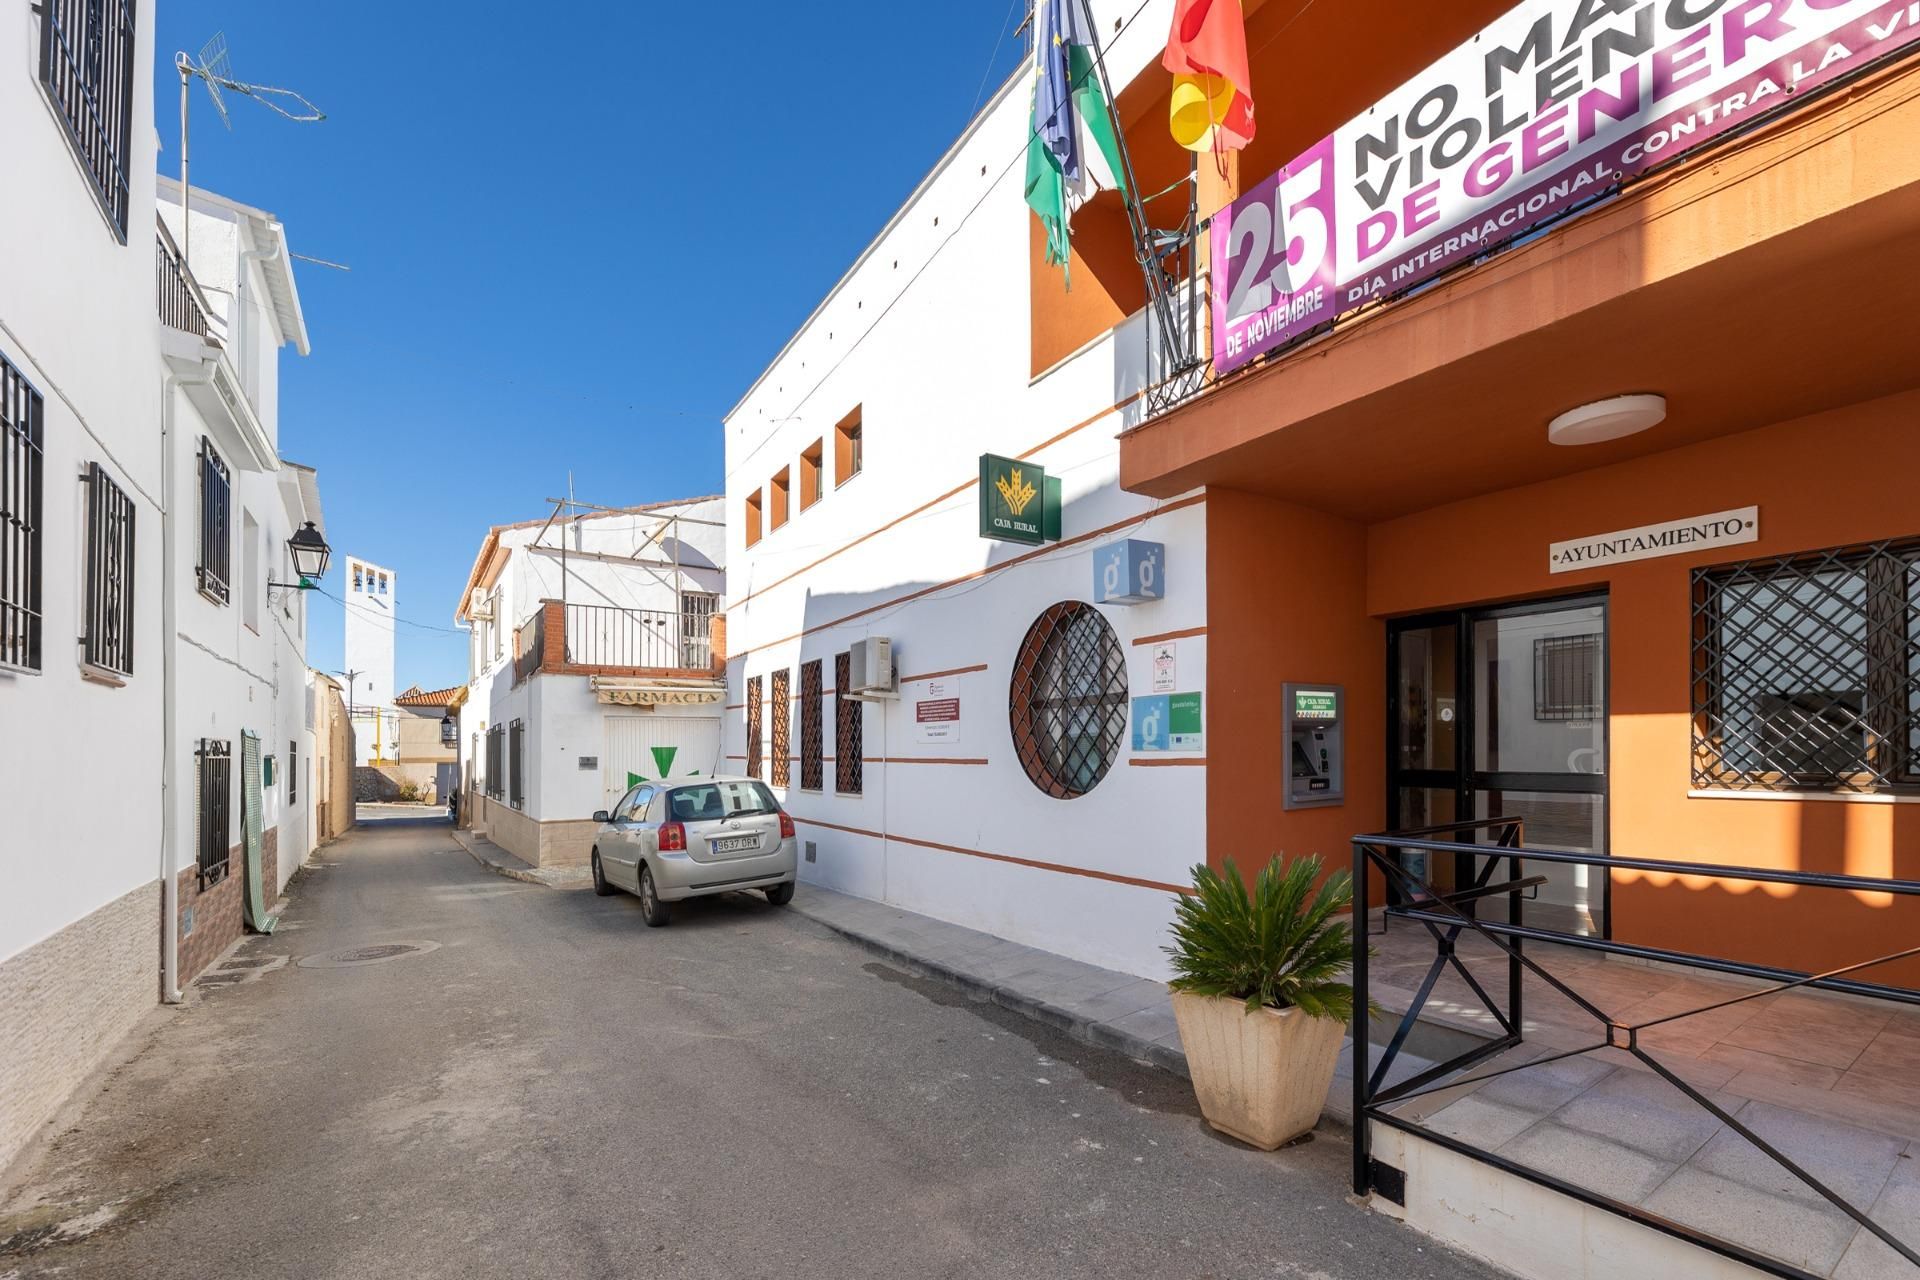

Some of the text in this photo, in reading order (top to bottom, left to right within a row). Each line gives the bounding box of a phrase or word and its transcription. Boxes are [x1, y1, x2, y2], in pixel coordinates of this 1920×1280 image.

[1356, 84, 1458, 179] NO
[1357, 0, 1843, 263] DE GÉNER
[1348, 278, 1386, 303] DÍA
[1391, 161, 1612, 282] INTERNACIONAL
[1621, 78, 1780, 164] CONTRA
[1792, 42, 1852, 83] LA
[1225, 157, 1328, 329] 25
[1226, 284, 1324, 359] DE NOVIEMBRE
[994, 518, 1039, 534] CAJA RURAL
[1560, 518, 1743, 564] AYUNTAMIENTO
[609, 691, 720, 703] FARMACIA
[718, 839, 739, 850] 9637
